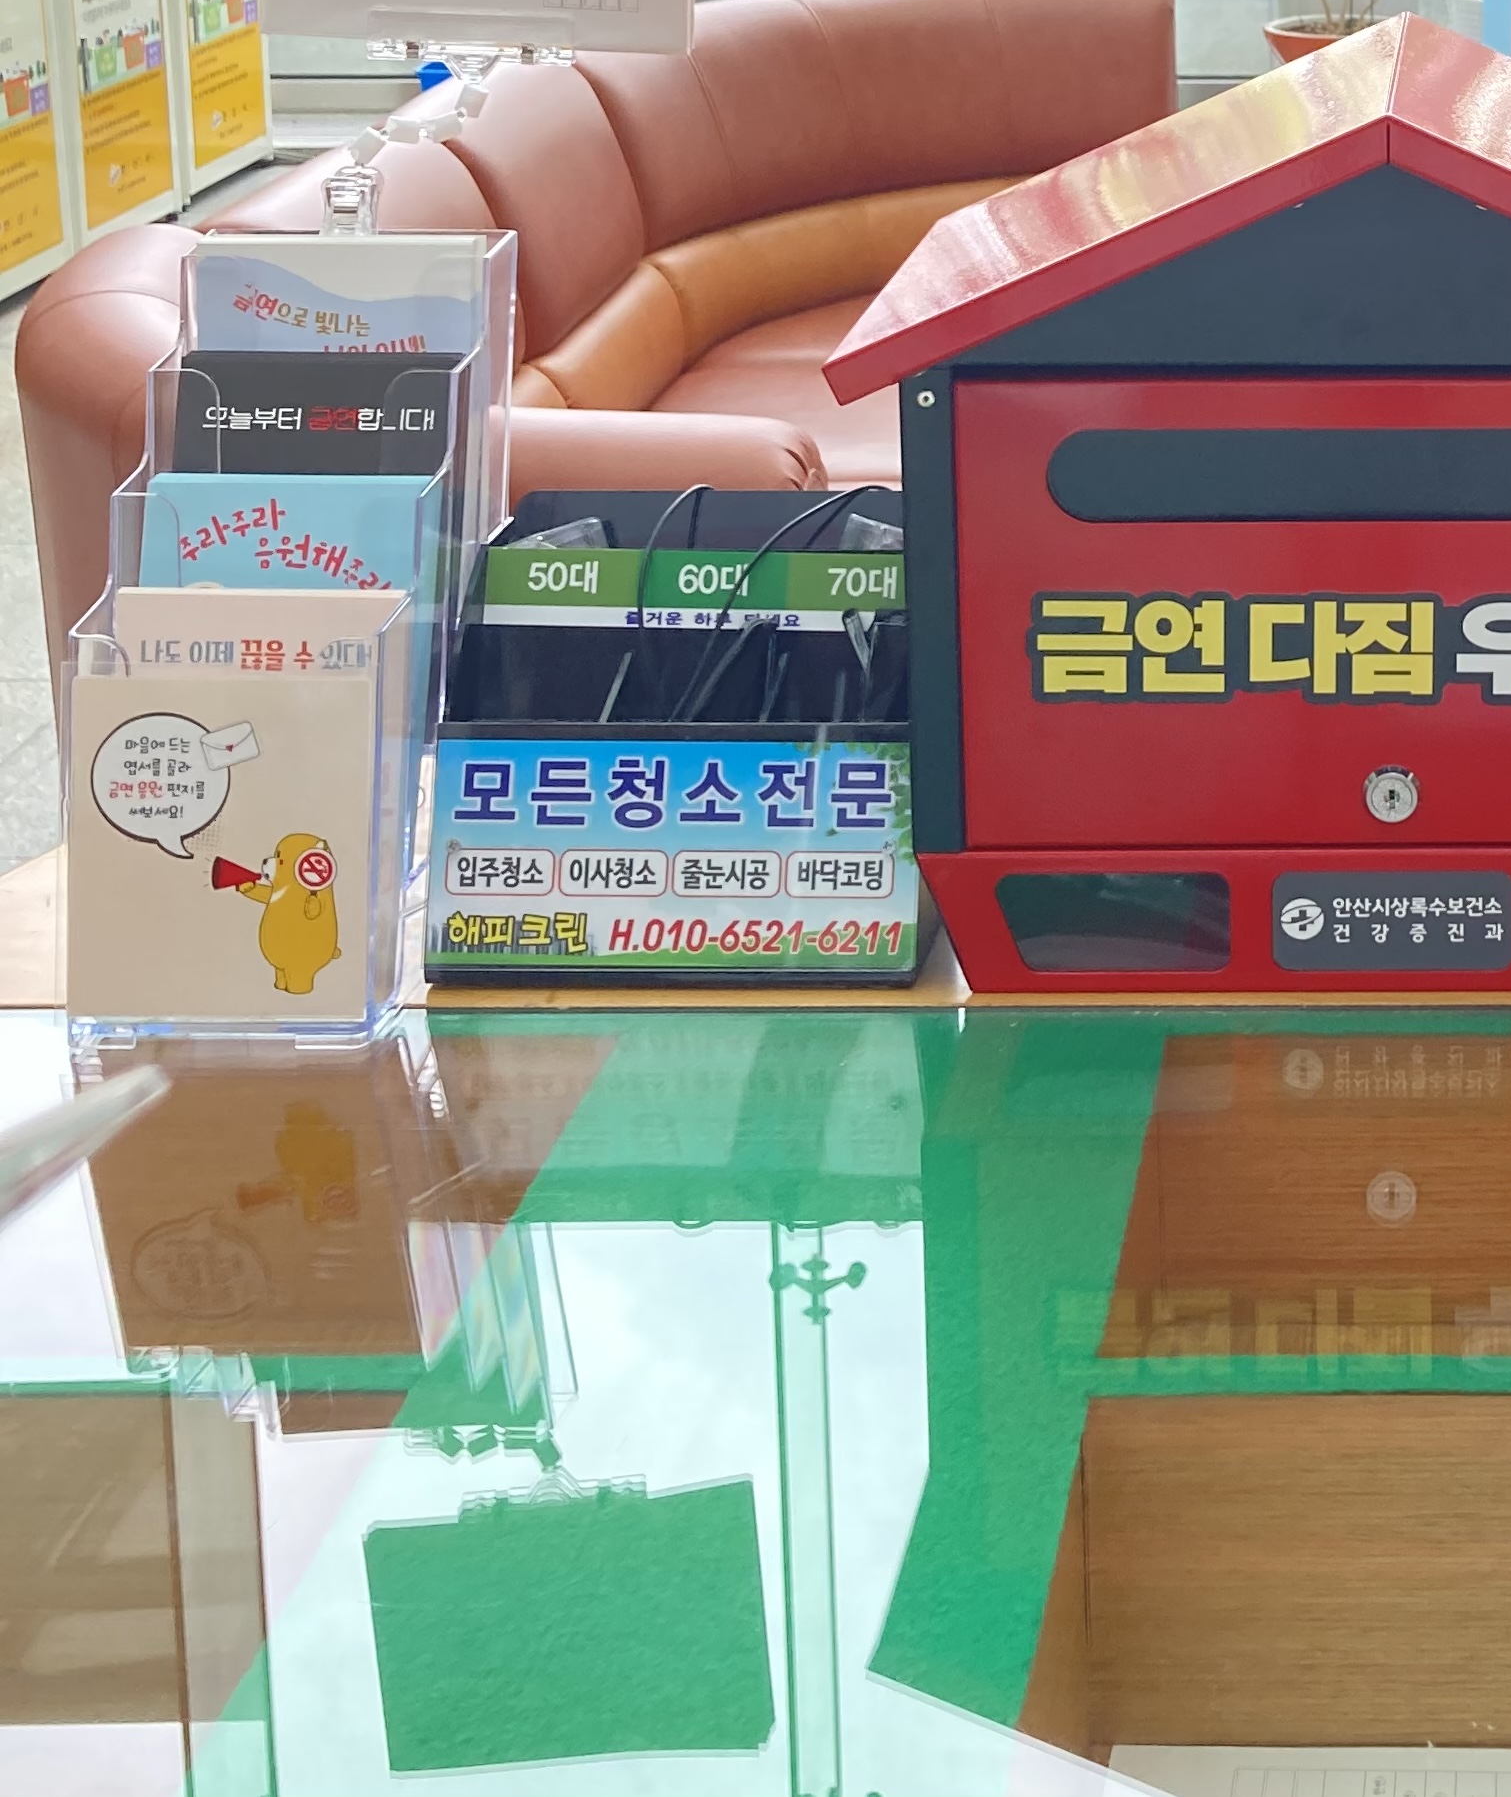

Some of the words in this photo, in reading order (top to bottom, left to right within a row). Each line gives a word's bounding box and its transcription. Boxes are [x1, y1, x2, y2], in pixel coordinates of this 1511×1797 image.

[314, 309, 371, 338] 빛나는
[201, 406, 302, 431] 오늘부터
[179, 497, 287, 562] 주라주라
[527, 560, 599, 594] 50대
[678, 563, 749, 597] 60대
[827, 566, 898, 601] 70대
[140, 639, 181, 664] 나도
[189, 640, 235, 664] 이제
[240, 638, 286, 673] 끊을
[293, 639, 315, 671] 수
[1036, 599, 1226, 695] 금연
[1248, 599, 1436, 696] 다짐
[124, 735, 166, 755] 마음에
[168, 736, 191, 755] 드는
[123, 756, 161, 777] 엽서를
[167, 757, 192, 777] 골라
[109, 780, 134, 800] 금연
[137, 779, 163, 800] 응원
[166, 780, 205, 801] 편지를
[457, 855, 544, 889] 입주청소
[569, 857, 657, 890] 이사청소
[680, 857, 770, 891] 줄눈시공
[797, 858, 884, 892] 바닥코팅
[1332, 896, 1503, 919] 안산시상록수보건소
[607, 918, 902, 954] H.010-6521-6211
